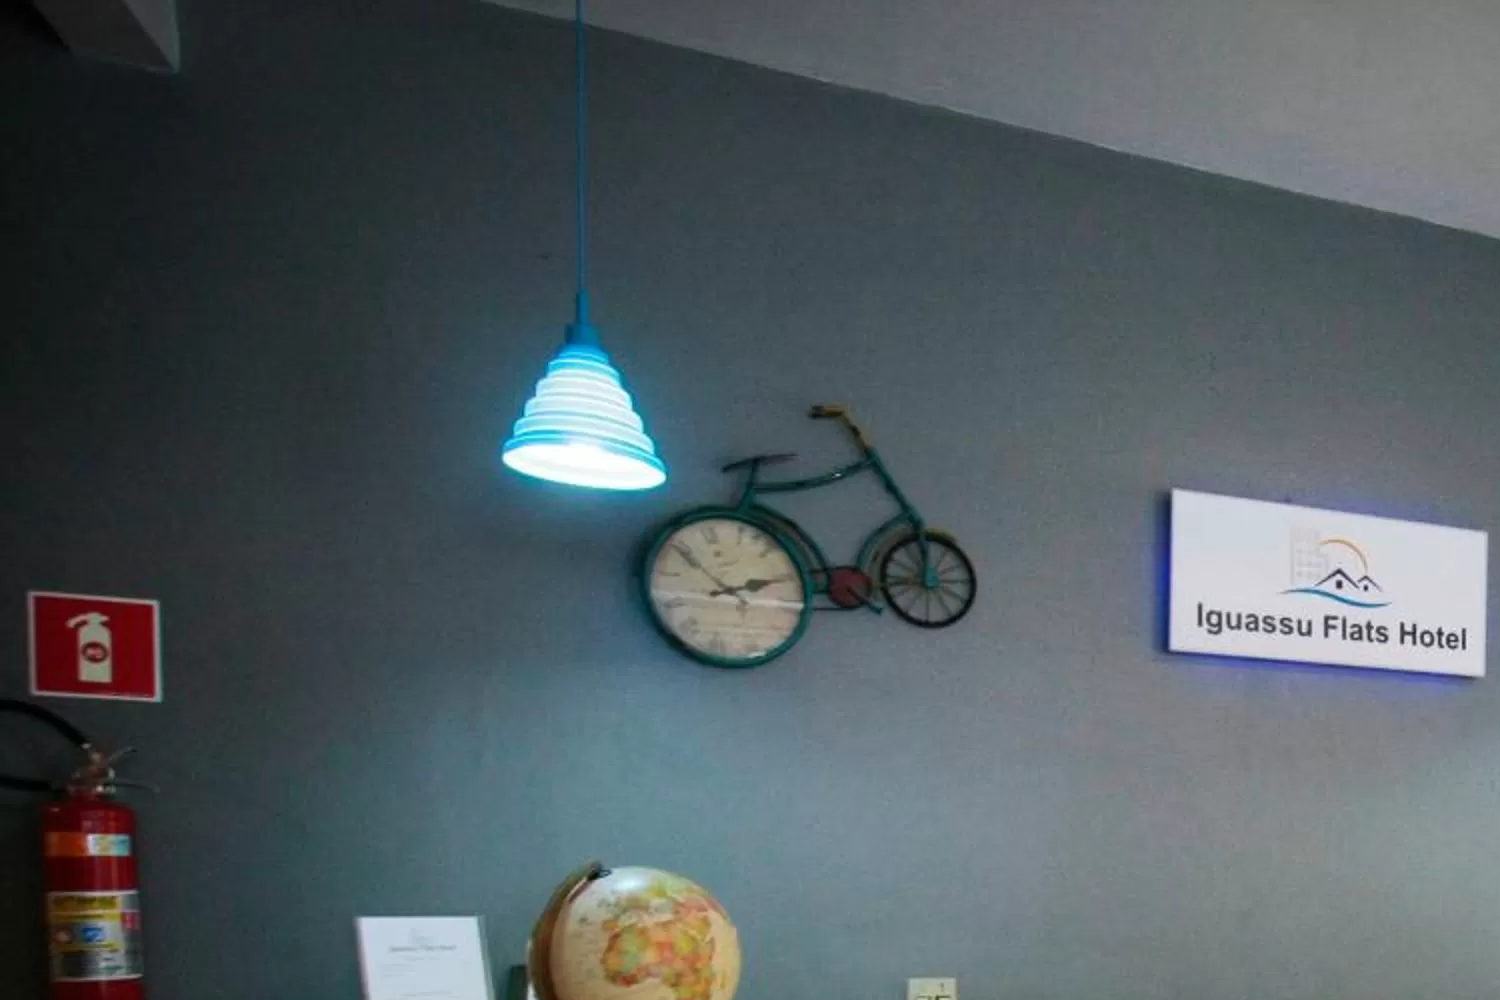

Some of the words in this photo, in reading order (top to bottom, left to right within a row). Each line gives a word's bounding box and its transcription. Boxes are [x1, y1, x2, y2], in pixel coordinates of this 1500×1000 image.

[1197, 602, 1312, 635] Iguassu
[1323, 615, 1389, 644] Flats
[1400, 622, 1467, 651] Hotel
